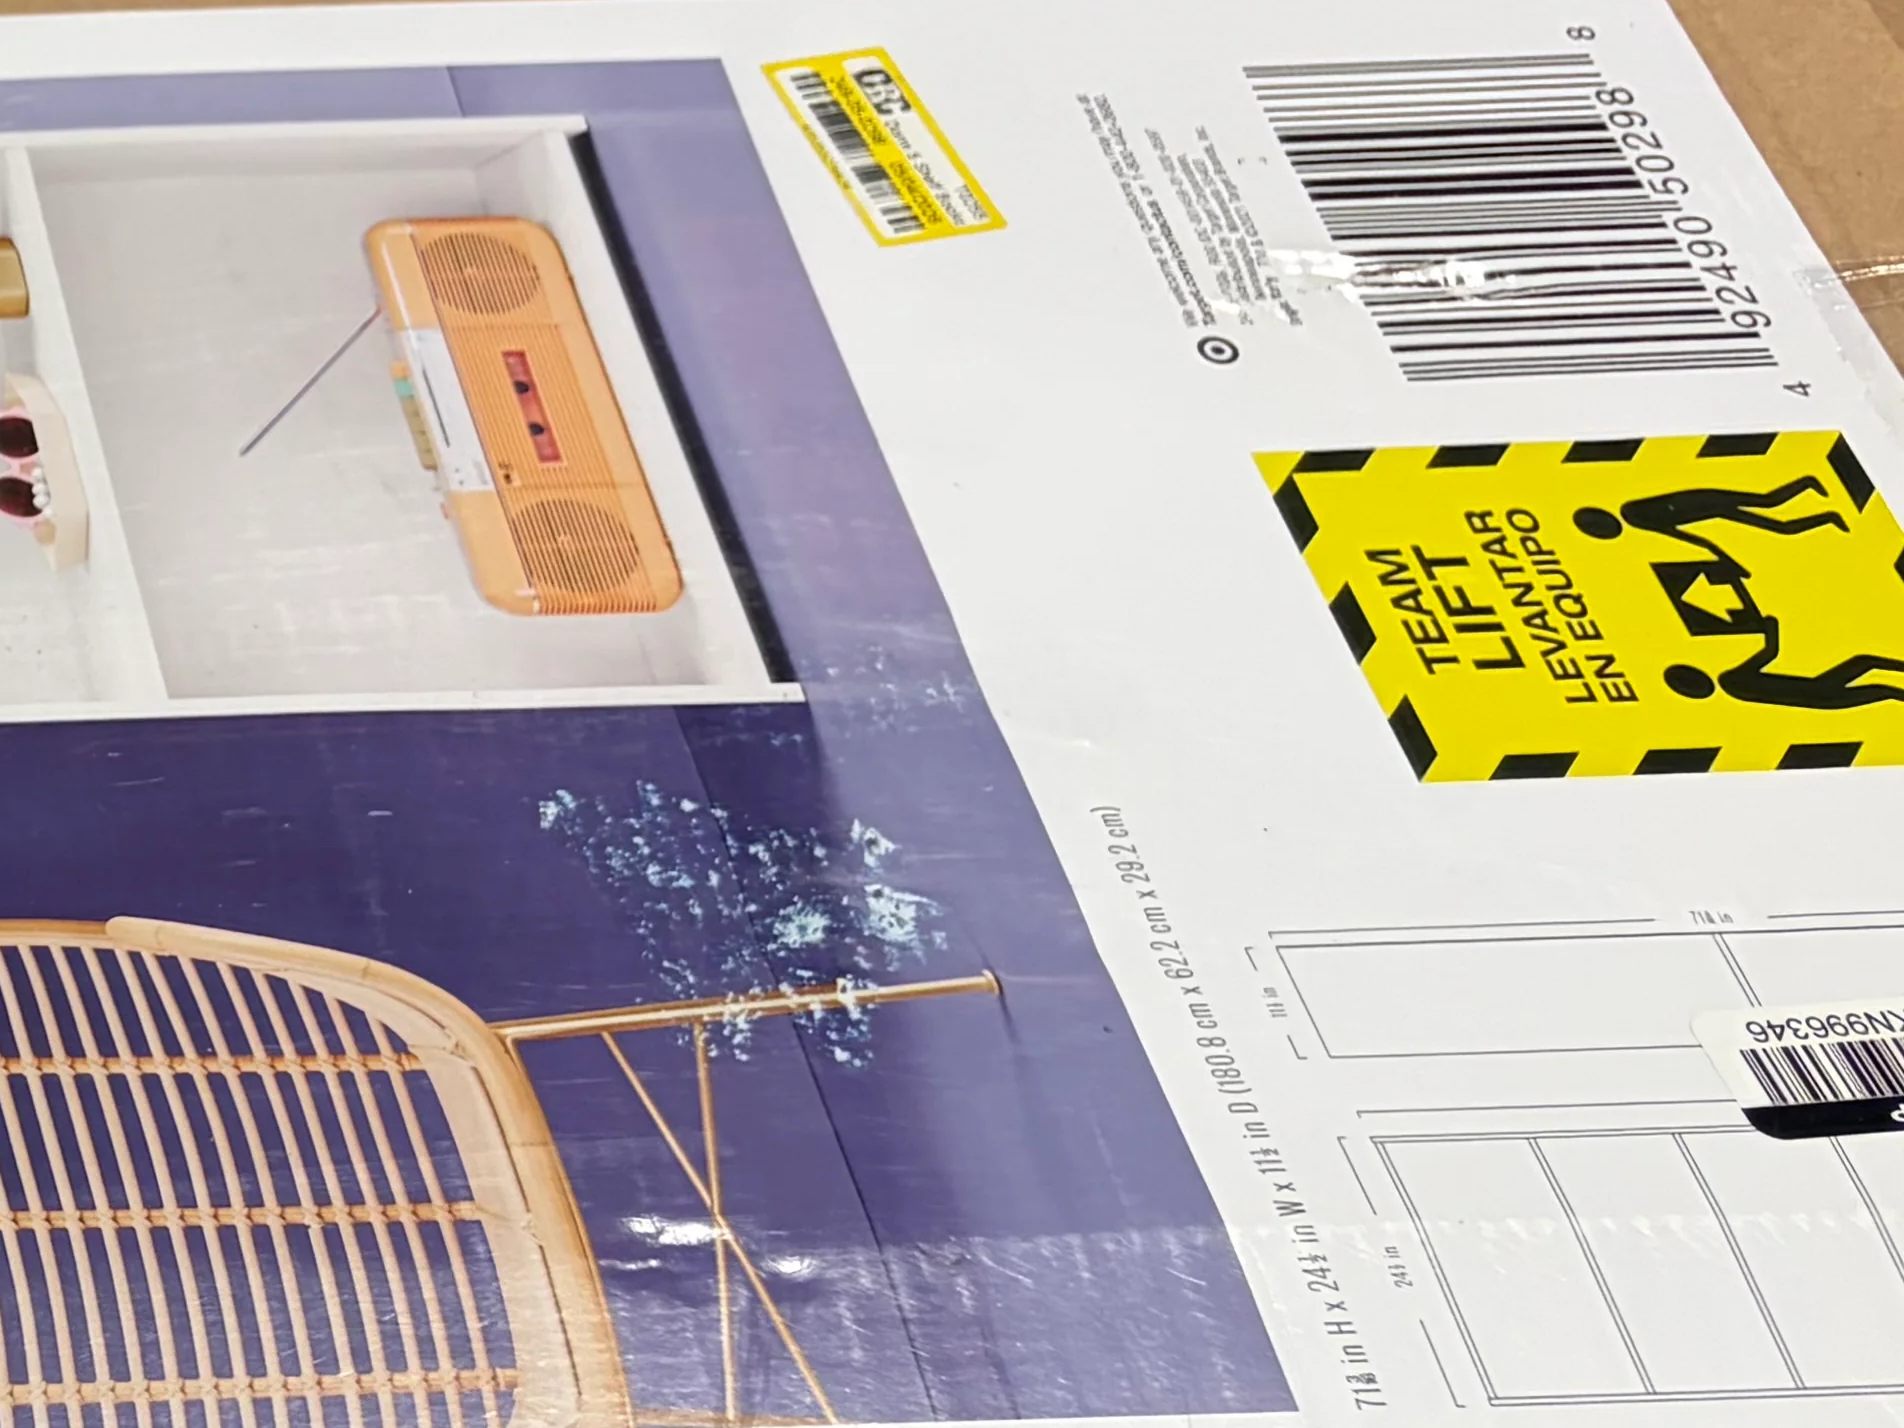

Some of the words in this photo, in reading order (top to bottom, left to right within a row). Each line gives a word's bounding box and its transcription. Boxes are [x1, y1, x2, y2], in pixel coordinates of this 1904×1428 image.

[1566, 26, 1596, 41] 8
[1595, 87, 1689, 196] 50298
[1673, 215, 1772, 329] 92490
[1783, 381, 1811, 397] 4
[1505, 508, 1604, 641] EQUIPO
[1364, 549, 1461, 675] TEAM
[1411, 544, 1526, 670] LIFT
[1464, 510, 1598, 703] LEVANTAR
[1584, 654, 1640, 703] EN
[1087, 806, 1132, 837] cm)
[1105, 844, 1151, 883] 29.2
[1134, 889, 1159, 898] x
[1141, 906, 1173, 933] cm
[1147, 940, 1195, 978] 62.2
[1179, 985, 1203, 995] x
[1186, 1003, 1219, 1028] cm
[1194, 1035, 1253, 1093] (180.8
[1224, 1101, 1259, 1113] D
[1236, 1121, 1271, 1138] in
[1271, 1181, 1296, 1191] x
[1271, 1199, 1309, 1216] W
[1285, 1224, 1320, 1243] in
[1322, 1300, 1348, 1311] x
[1322, 1321, 1358, 1334] H
[1333, 1344, 1370, 1363] in
